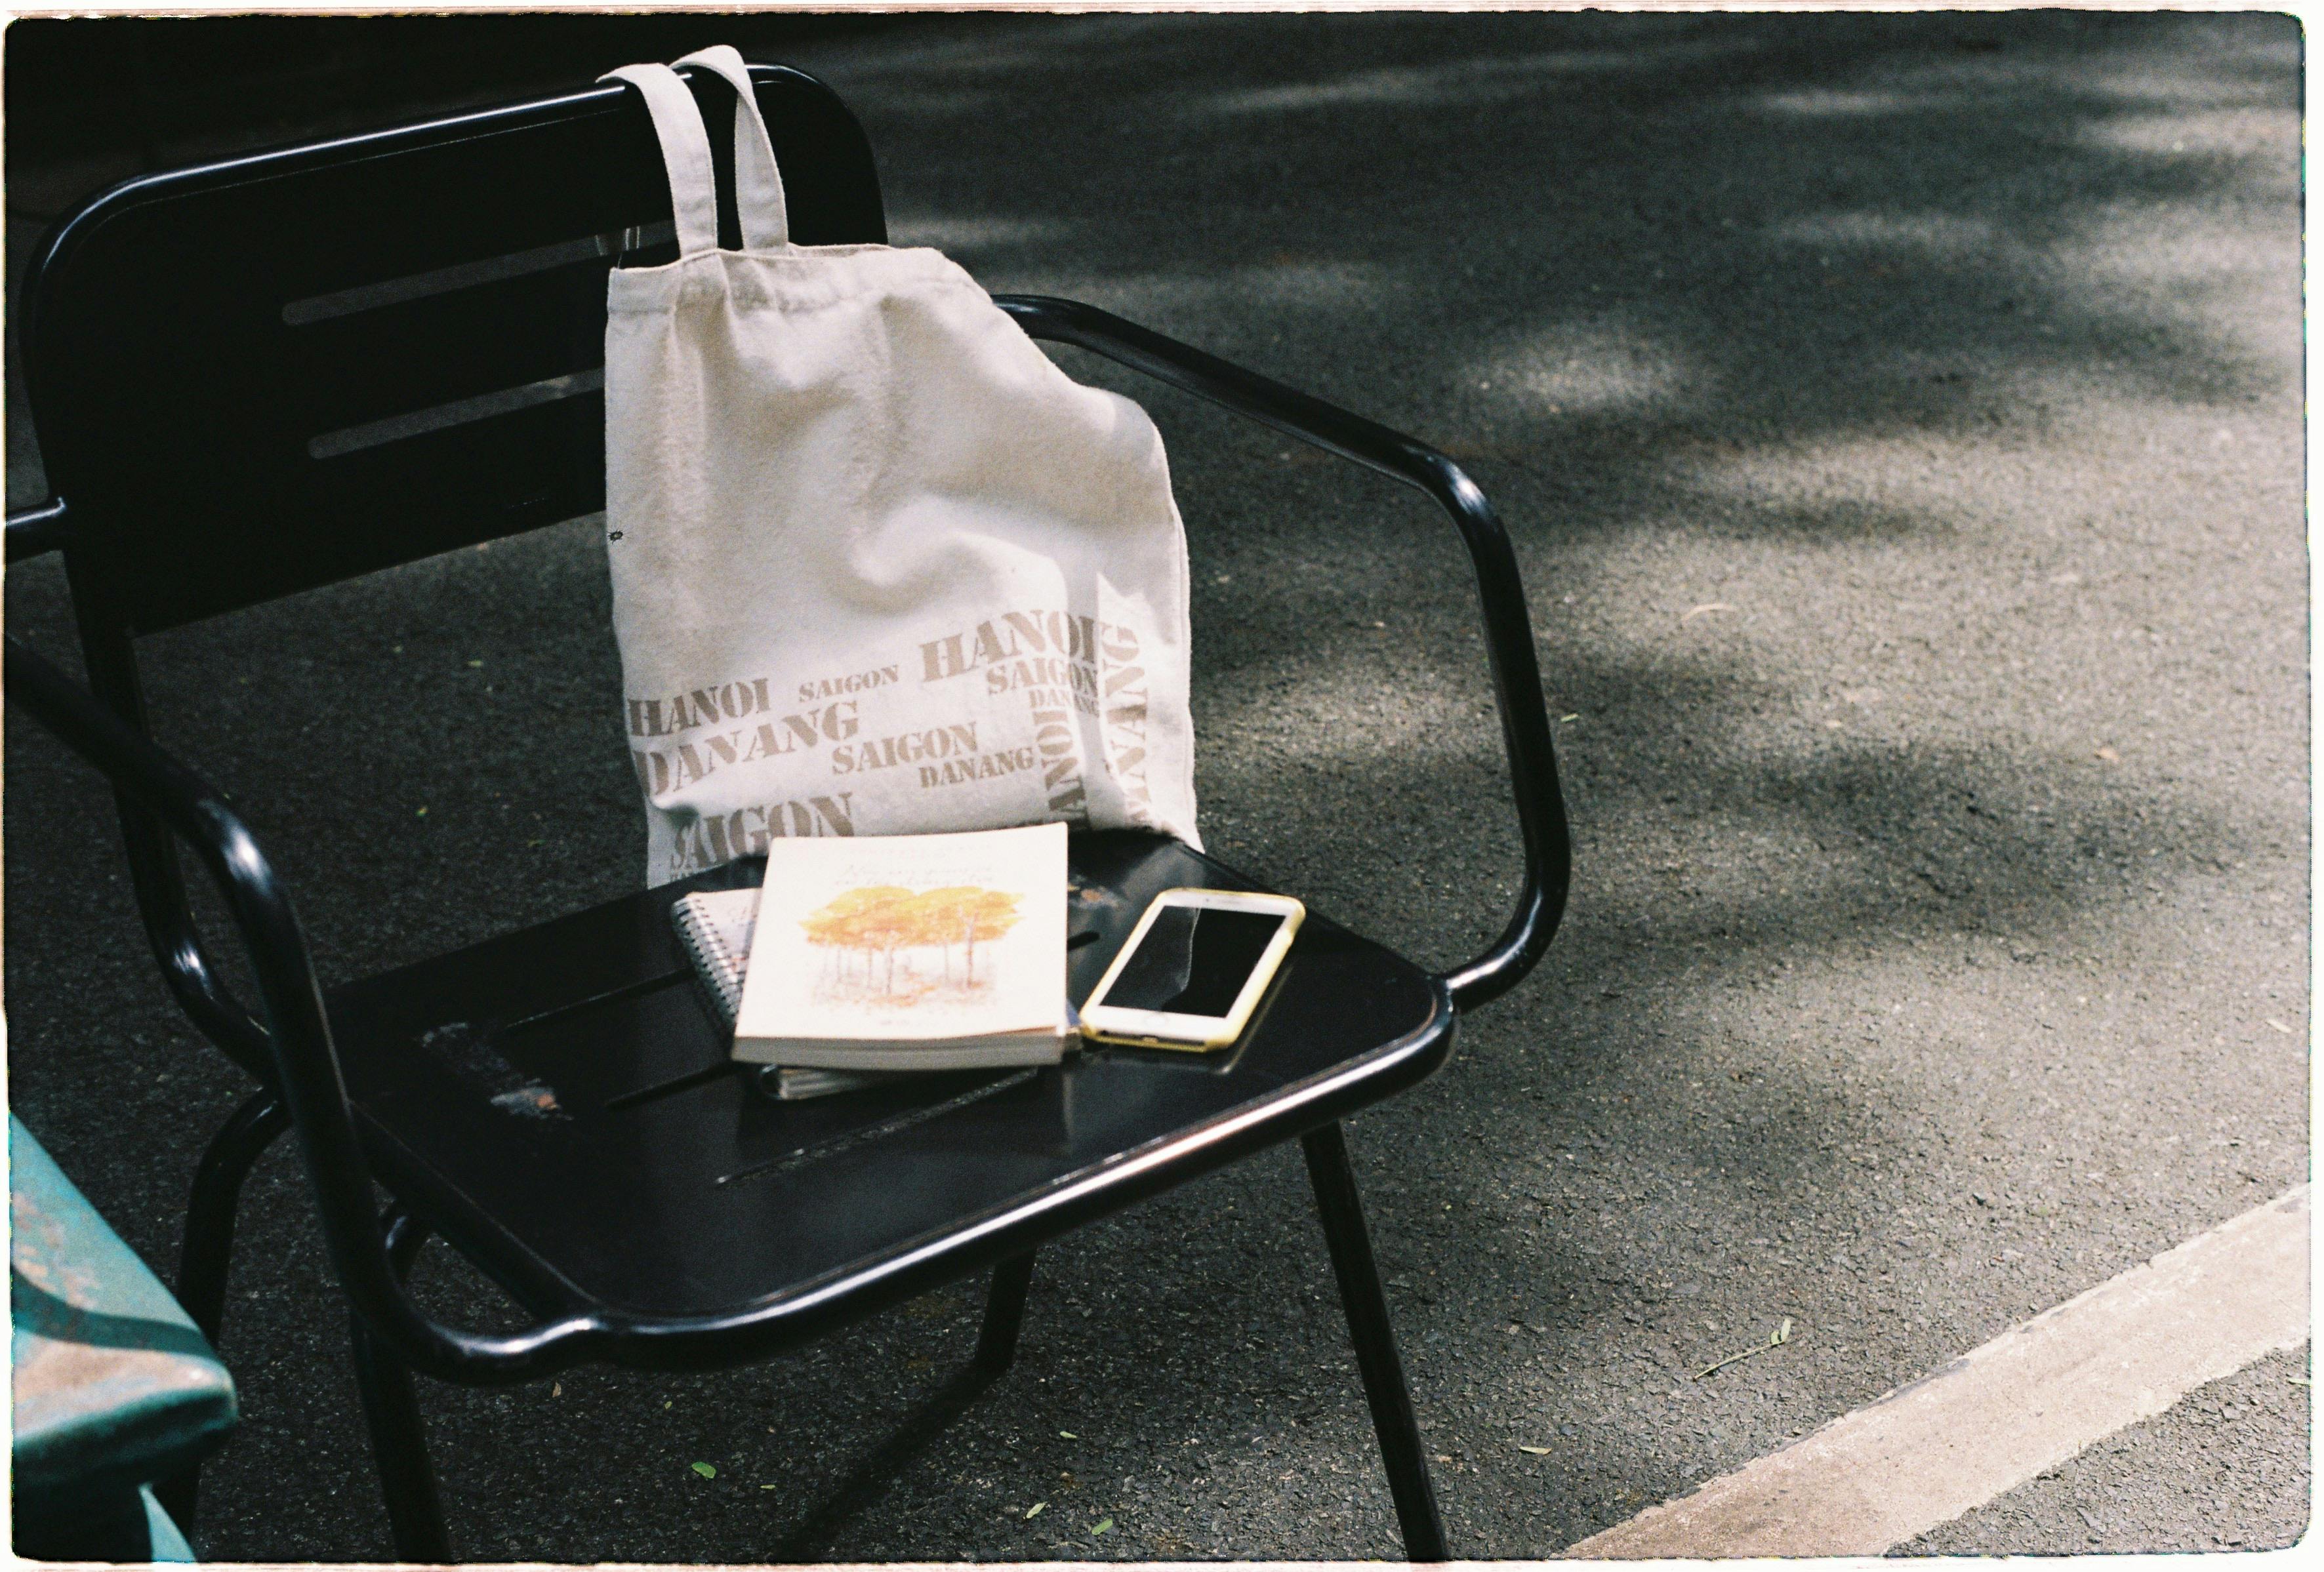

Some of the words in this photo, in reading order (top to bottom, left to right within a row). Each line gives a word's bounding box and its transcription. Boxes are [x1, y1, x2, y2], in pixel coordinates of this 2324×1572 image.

[920, 608, 1094, 682] HANOI
[798, 664, 899, 702] SAIGON
[986, 657, 1098, 696] SAIGON
[628, 677, 771, 736] HANOI
[1101, 622, 1151, 824] NANG
[633, 700, 859, 796] DANANG
[831, 722, 978, 776] SAIGON
[920, 748, 1034, 788] DANANG
[1032, 710, 1090, 825] ANOI
